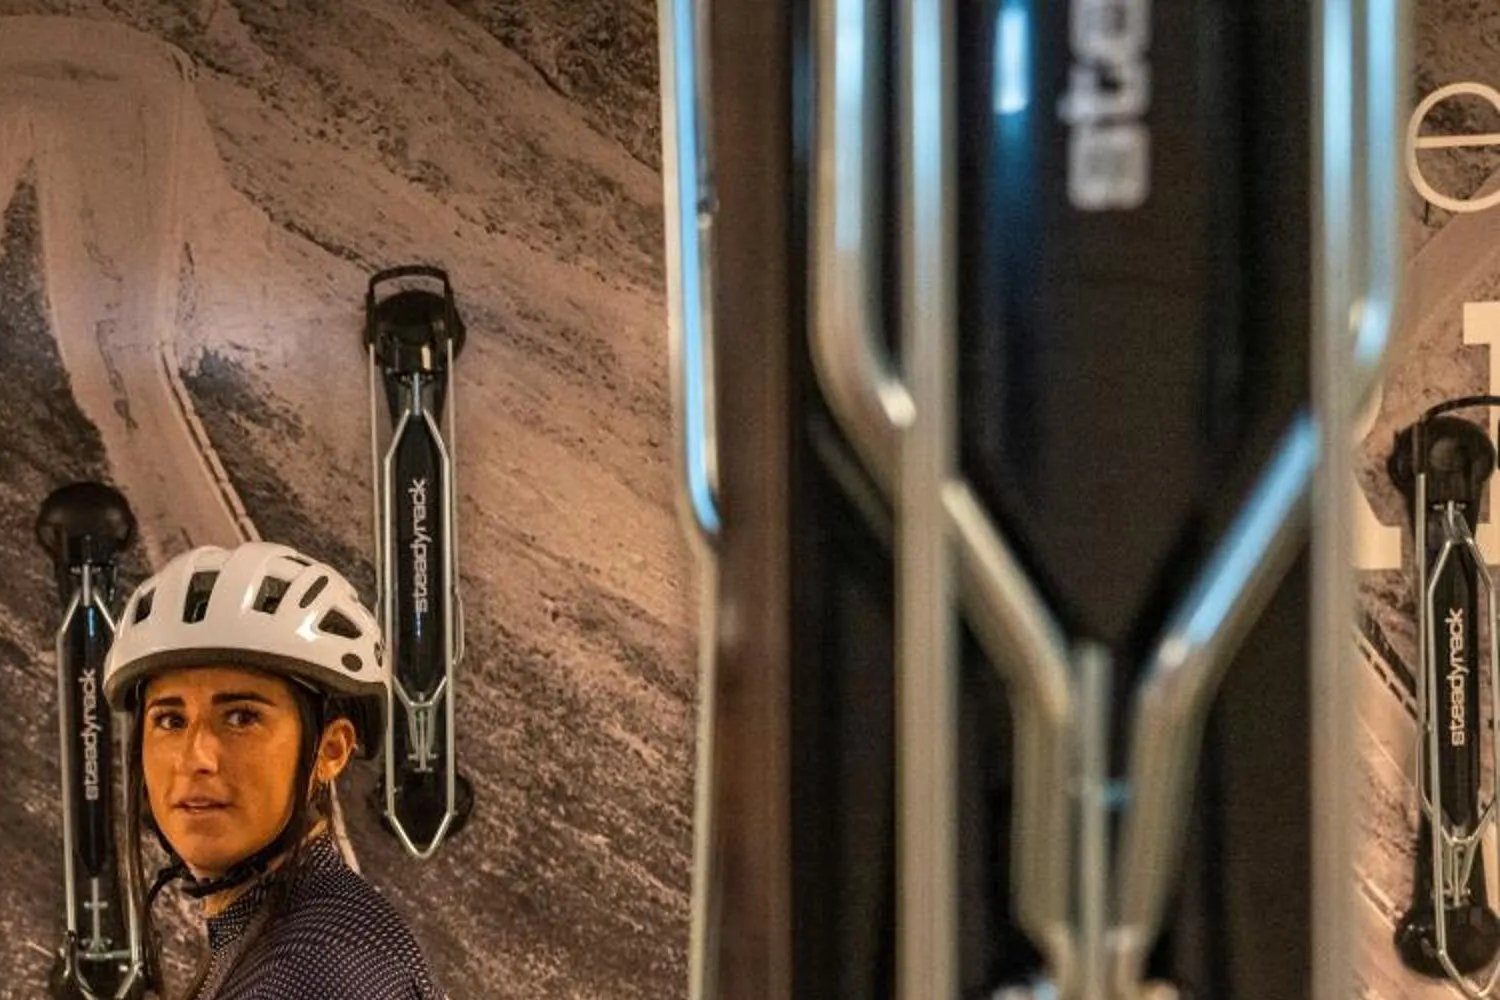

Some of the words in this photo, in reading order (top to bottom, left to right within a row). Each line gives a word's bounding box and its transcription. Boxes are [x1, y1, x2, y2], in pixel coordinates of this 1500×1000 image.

[407, 478, 434, 614] steadyrack
[78, 668, 101, 800] steadyrack
[1444, 607, 1470, 748] steadyrack
